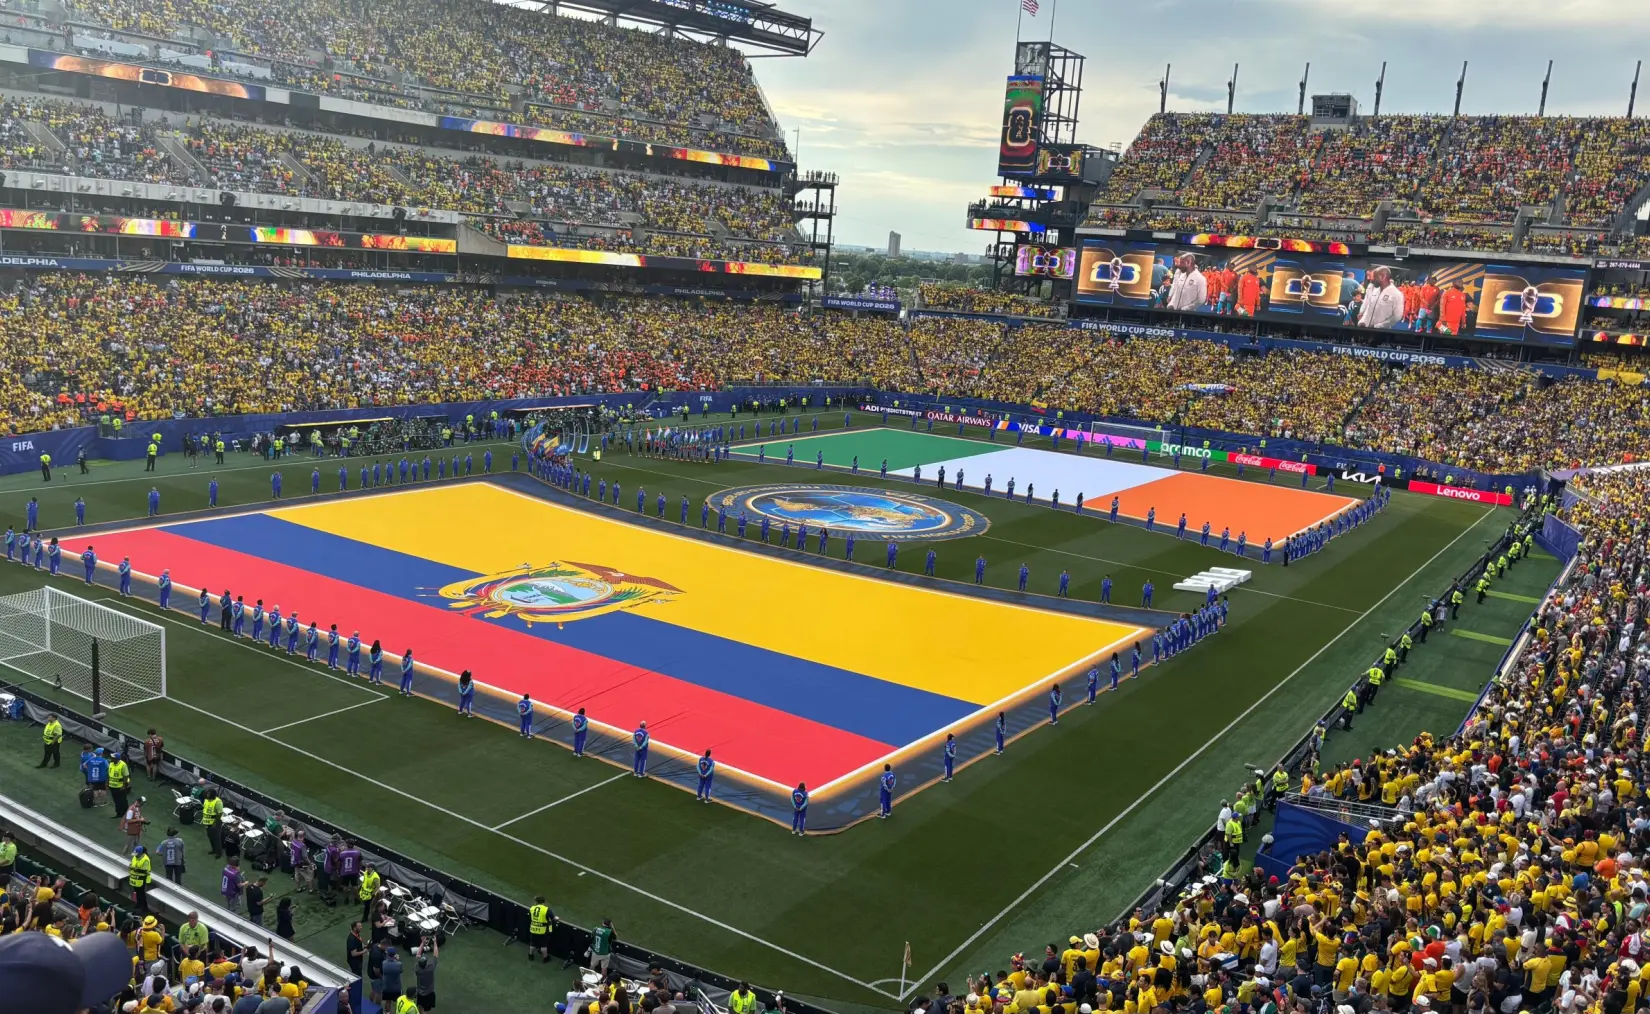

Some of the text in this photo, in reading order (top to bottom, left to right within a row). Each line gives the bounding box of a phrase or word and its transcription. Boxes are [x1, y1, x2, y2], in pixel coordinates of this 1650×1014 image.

[0, 257, 58, 266] DELPHIA
[181, 264, 195, 272] FIFA
[196, 265, 219, 273] WORLD
[351, 271, 411, 279] PHILADELPHIA
[674, 288, 725, 296] PHILADELPHIA
[1081, 322, 1175, 337] FIFA WORLD CUP 2026
[1332, 346, 1446, 365] FIFA WORLD CUP 2026
[865, 404, 879, 412] ADI
[927, 411, 991, 427] QATAR AIRWAYS
[1017, 422, 1041, 435] VISA
[12, 440, 34, 452] FIFA
[1161, 443, 1212, 458] aramco
[1436, 485, 1481, 501] Lenovo
